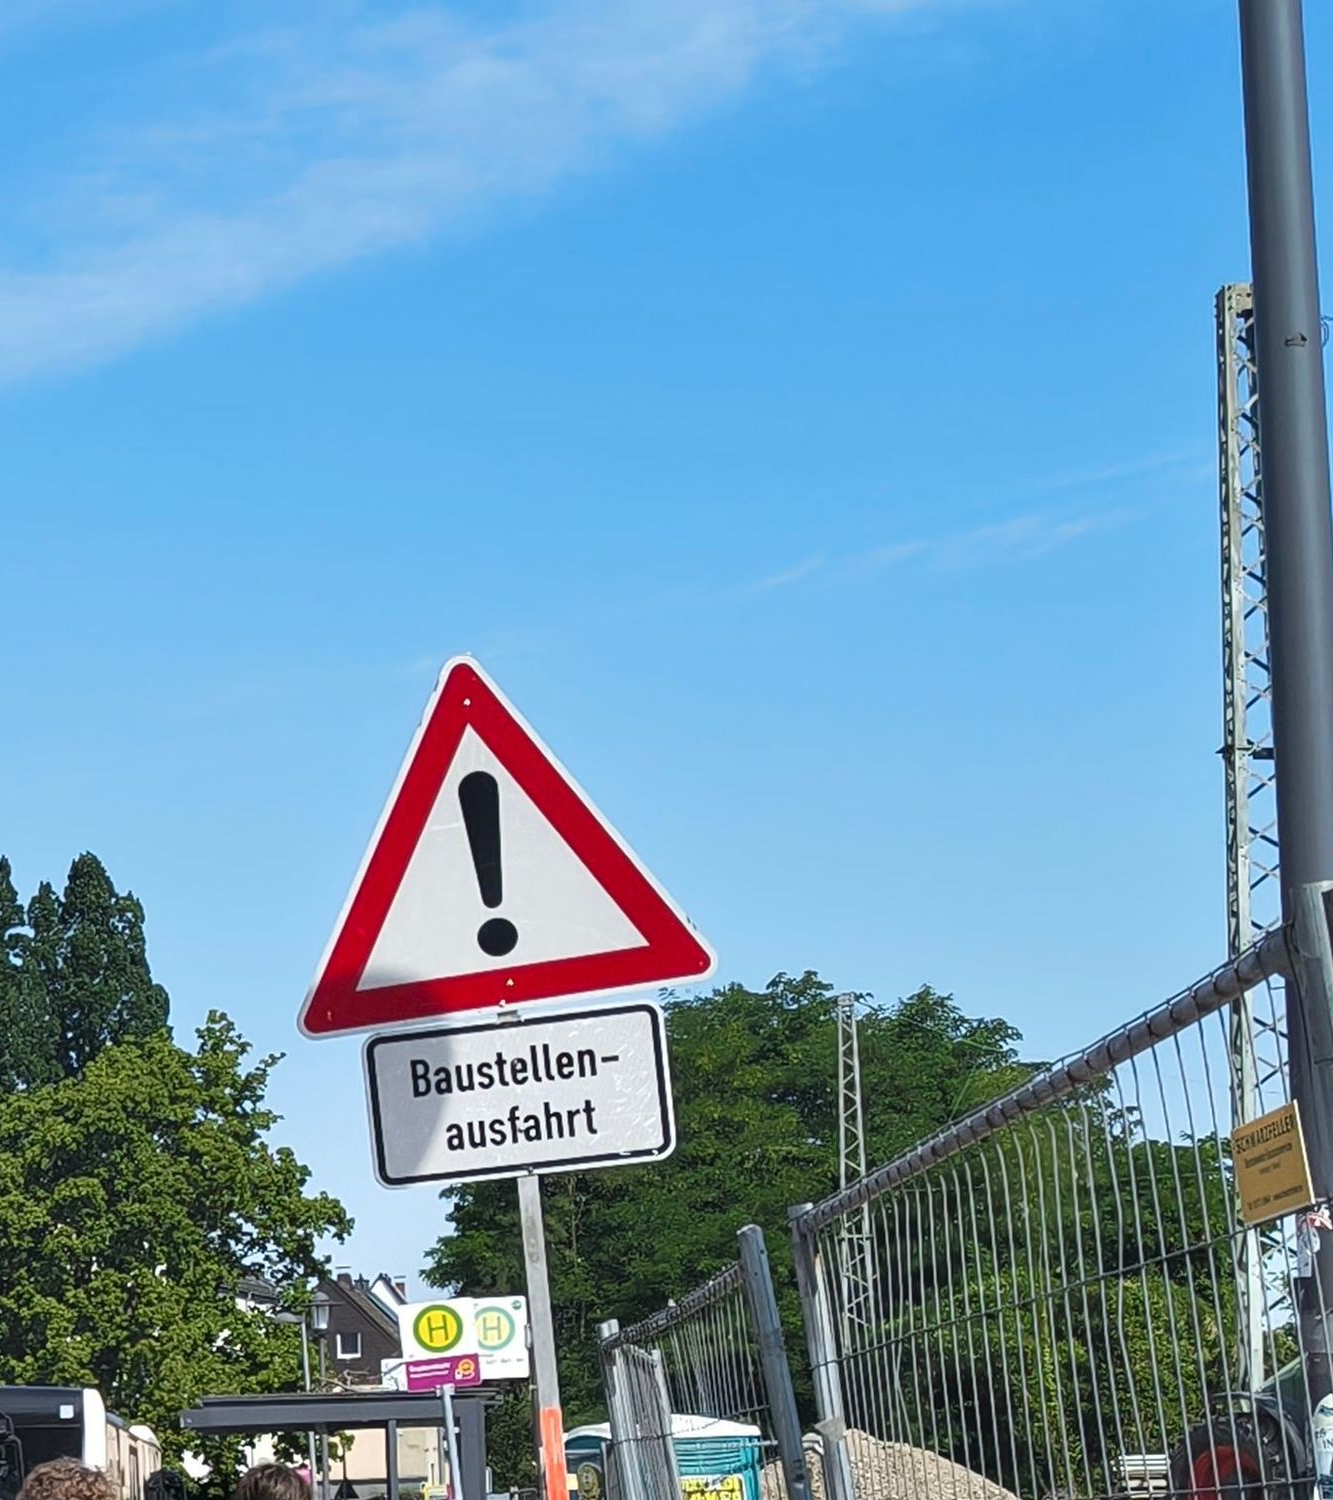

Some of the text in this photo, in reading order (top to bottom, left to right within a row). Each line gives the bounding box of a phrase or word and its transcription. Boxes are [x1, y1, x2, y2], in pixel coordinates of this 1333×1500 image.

[410, 1043, 620, 1098] Baustellen-
[445, 1099, 599, 1151] ausfahrt
[426, 1314, 449, 1343] H
[482, 1315, 502, 1341] H
